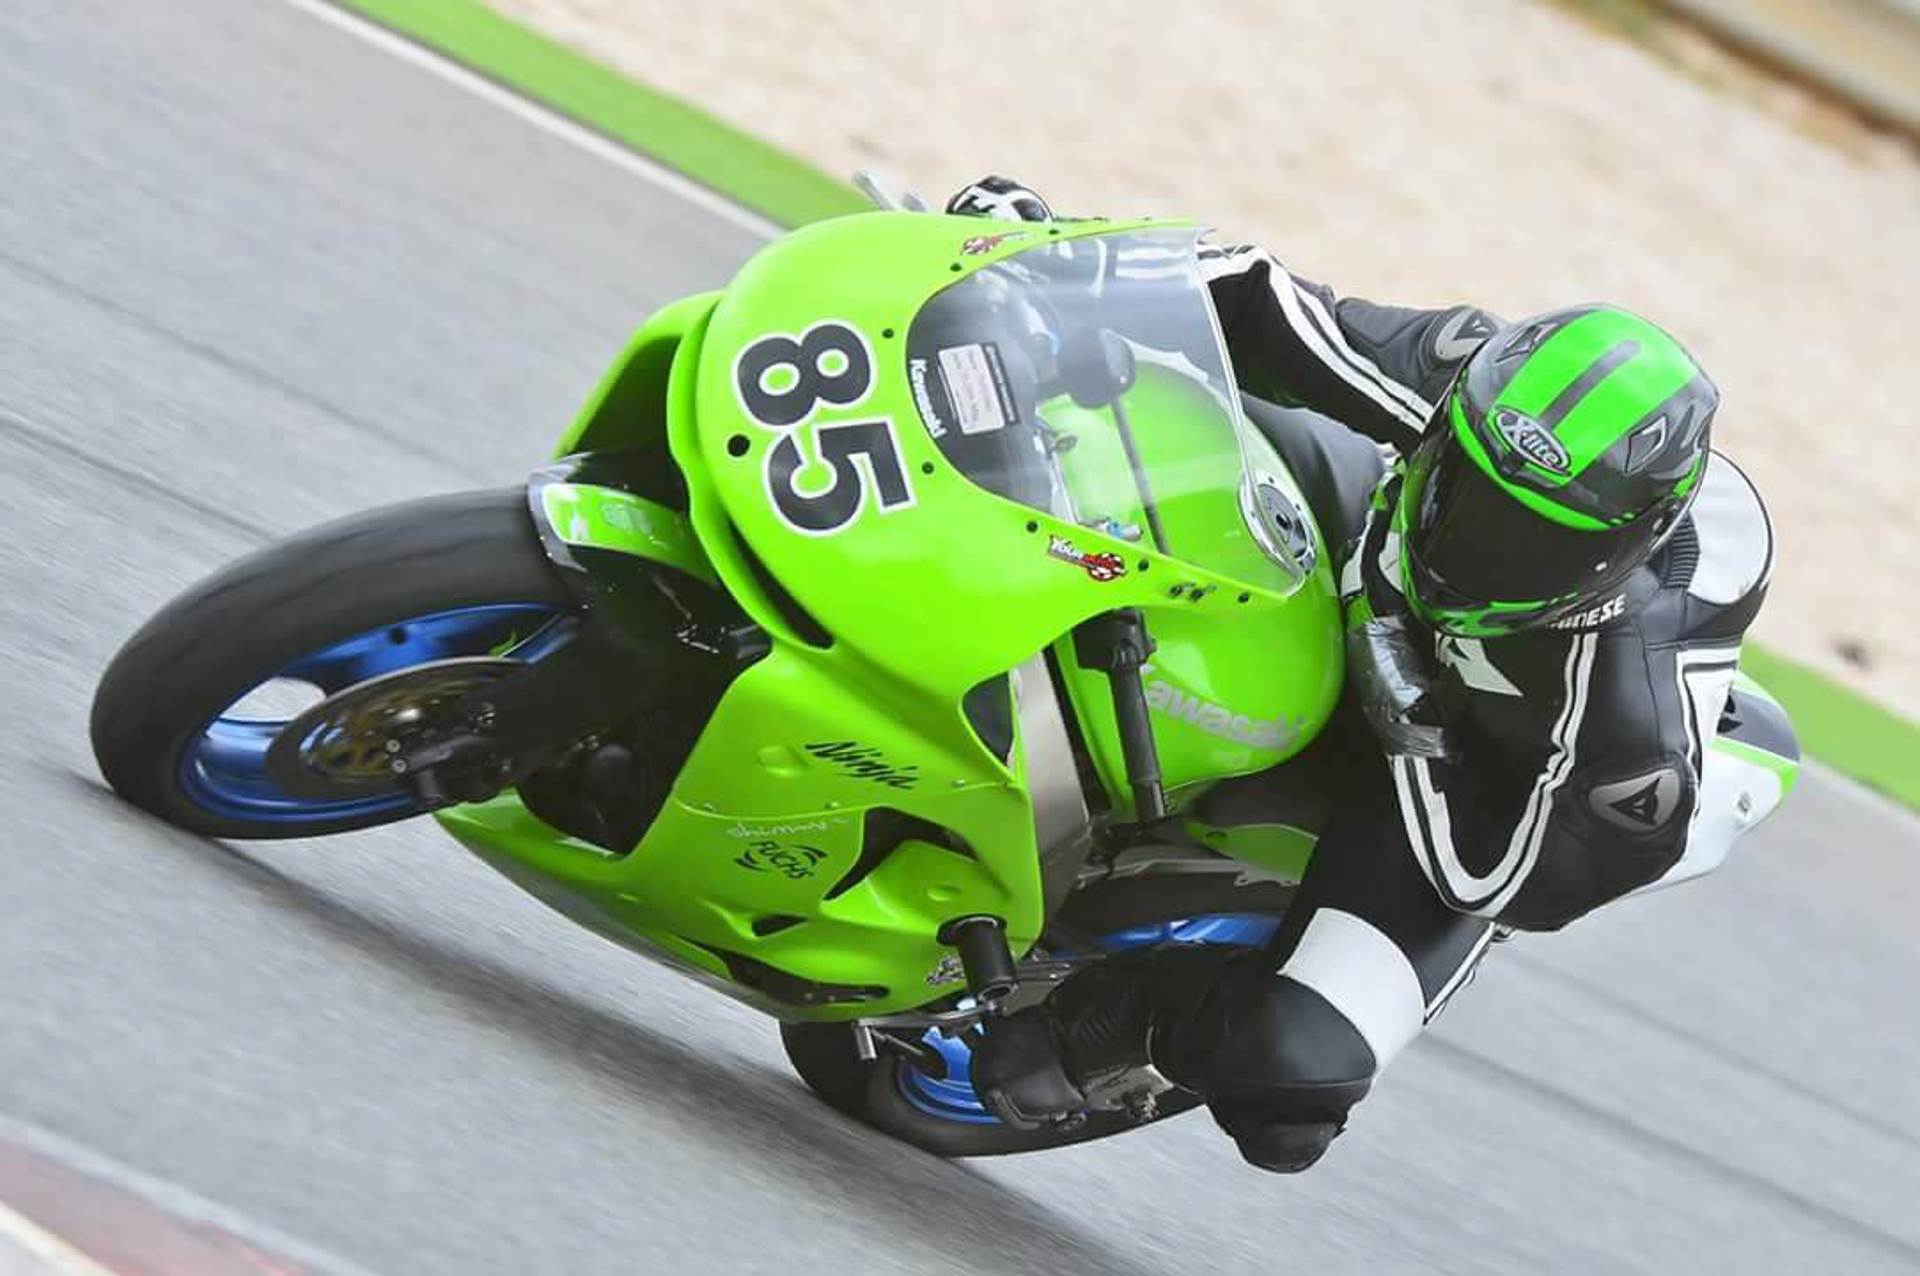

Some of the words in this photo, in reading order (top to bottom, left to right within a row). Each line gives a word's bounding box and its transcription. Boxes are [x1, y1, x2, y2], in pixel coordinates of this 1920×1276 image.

[734, 320, 914, 535] 85
[909, 358, 947, 438] Kawasaki
[1141, 667, 1310, 751] awasaki
[804, 741, 918, 790] Ninja
[748, 841, 815, 878] FUCHS
